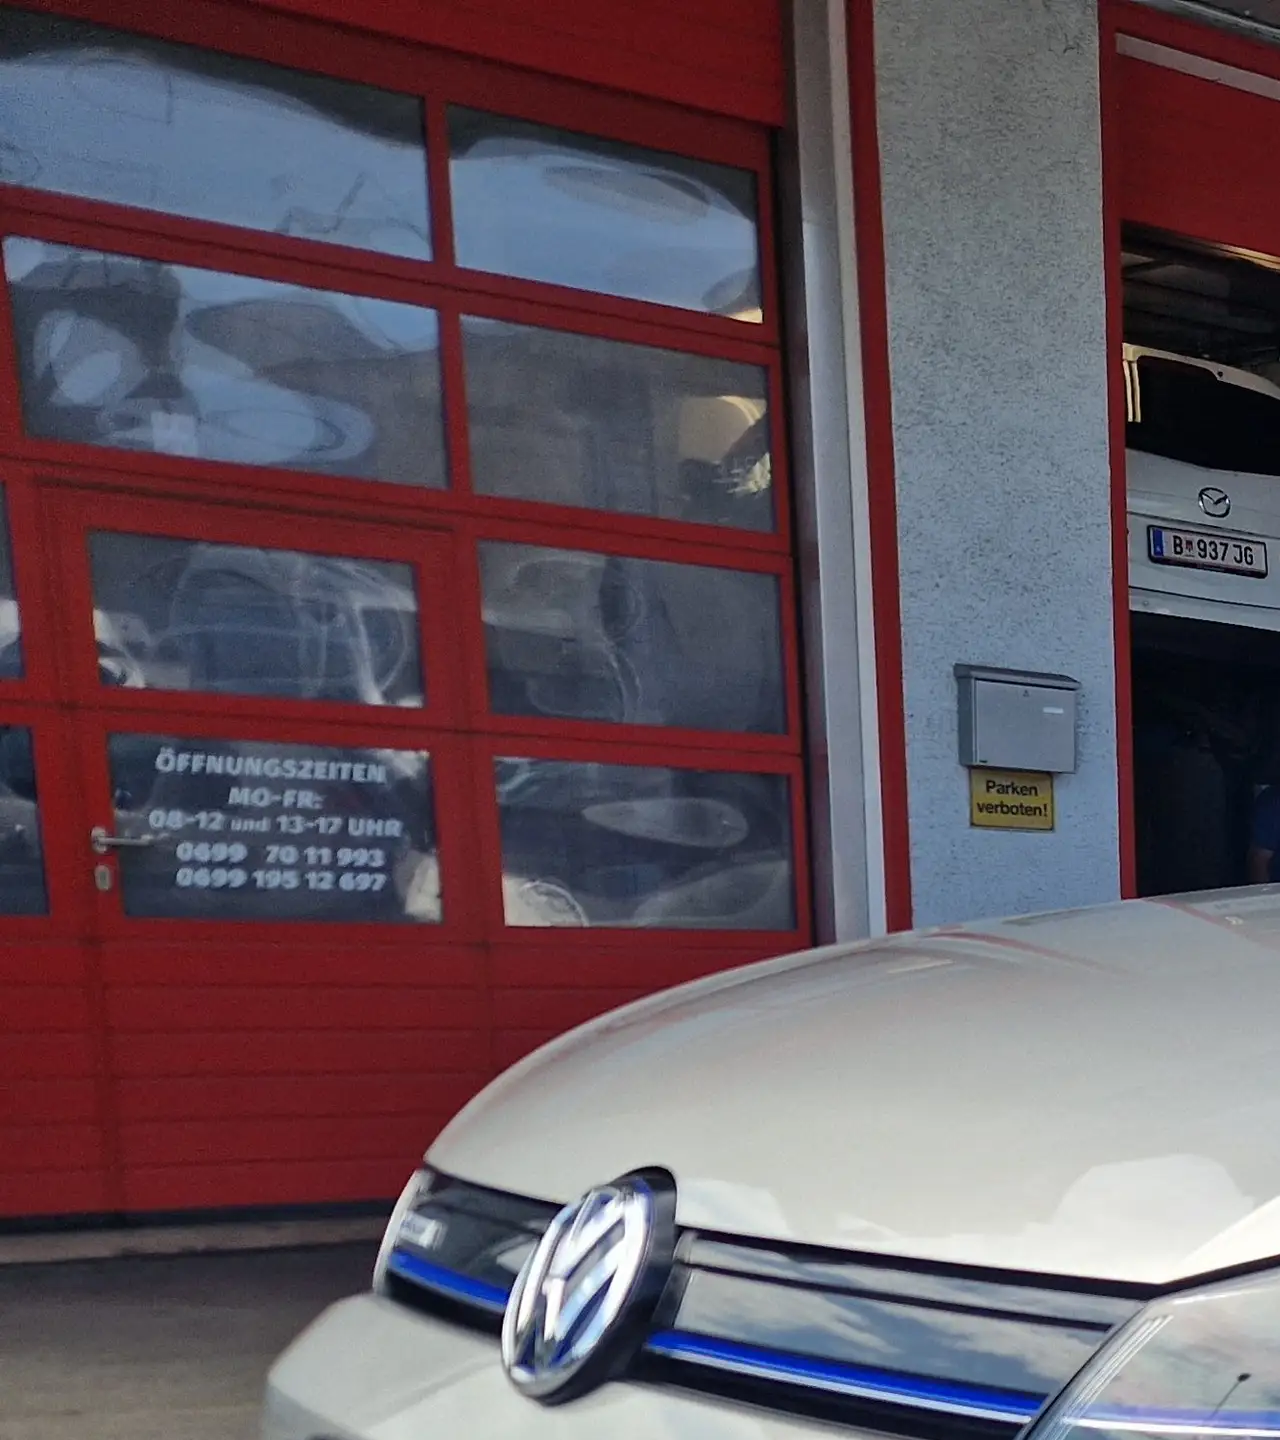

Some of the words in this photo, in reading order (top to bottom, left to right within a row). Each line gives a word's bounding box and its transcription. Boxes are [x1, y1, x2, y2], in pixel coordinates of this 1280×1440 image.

[1173, 535, 1184, 555] B
[1197, 539, 1229, 562] 937
[155, 747, 387, 784] ÖFFNUNGSZEITEN
[985, 780, 1038, 797] Parken
[976, 801, 1048, 818] verboten!
[148, 809, 227, 831] 08-12
[230, 816, 272, 833] und
[275, 814, 343, 835] 13-17
[348, 817, 404, 838] UHR
[266, 844, 299, 865] 70
[303, 846, 333, 865] 11
[304, 871, 336, 891] 12
[338, 872, 387, 892] 697
